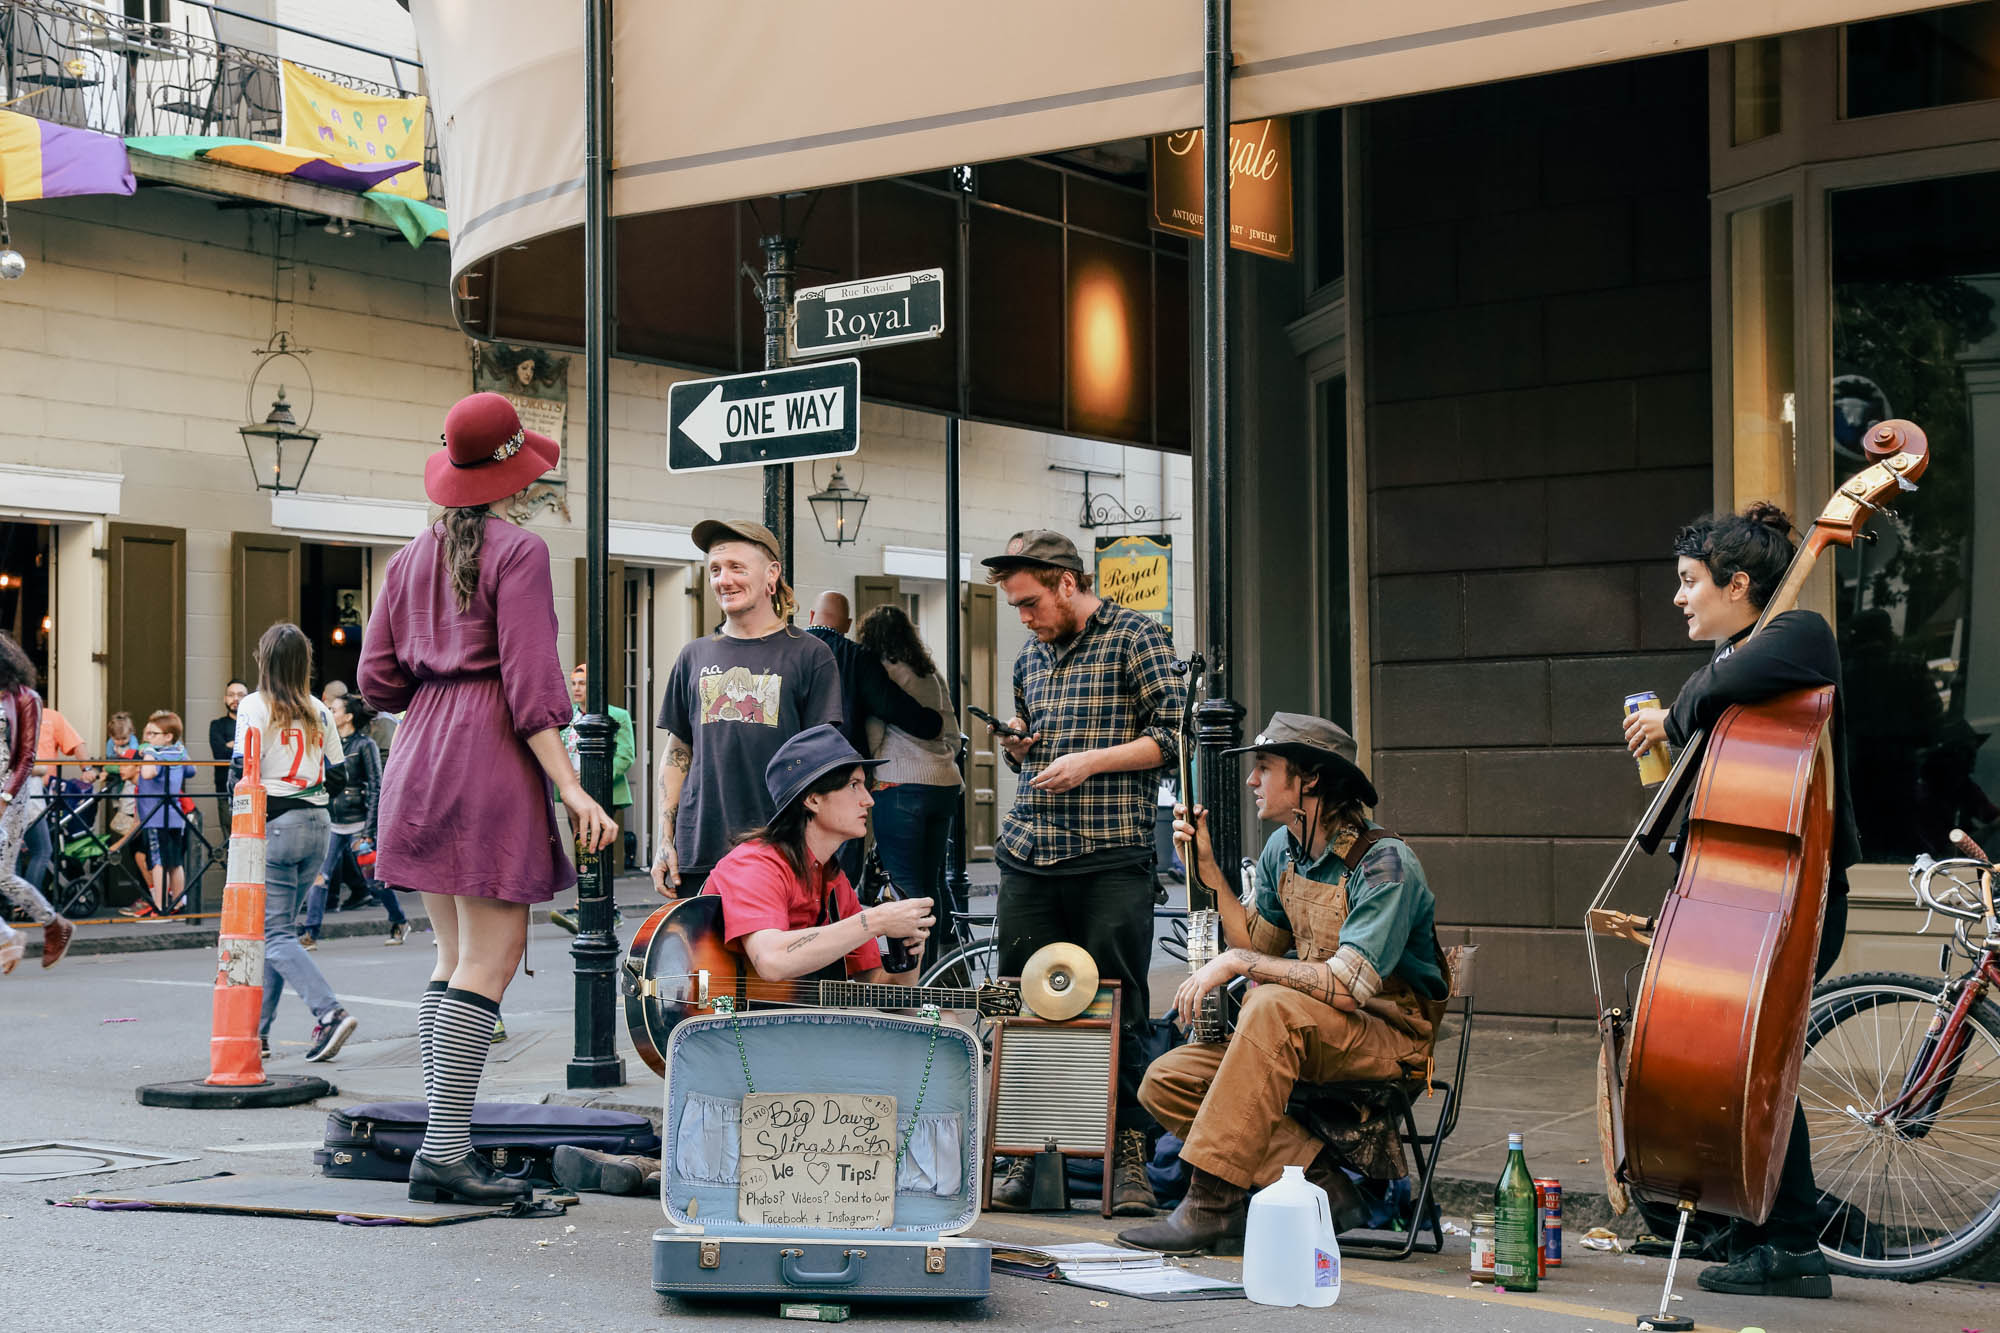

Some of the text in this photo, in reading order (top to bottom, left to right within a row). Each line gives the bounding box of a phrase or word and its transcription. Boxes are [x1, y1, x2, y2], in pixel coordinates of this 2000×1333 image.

[1230, 224, 1244, 235] ART
[1249, 228, 1277, 244] JEWELRY
[841, 281, 894, 298] Rue Royale
[824, 297, 912, 339] Royal
[726, 391, 837, 438] ONE WAY
[1103, 558, 1160, 589] Royal
[768, 1100, 880, 1137] Big Dawg
[772, 1160, 880, 1185] We Tips!
[746, 1190, 890, 1205] Photos? Videos? Send to Our
[762, 1210, 808, 1224] Facebook
[828, 1209, 881, 1226] Instagram!
